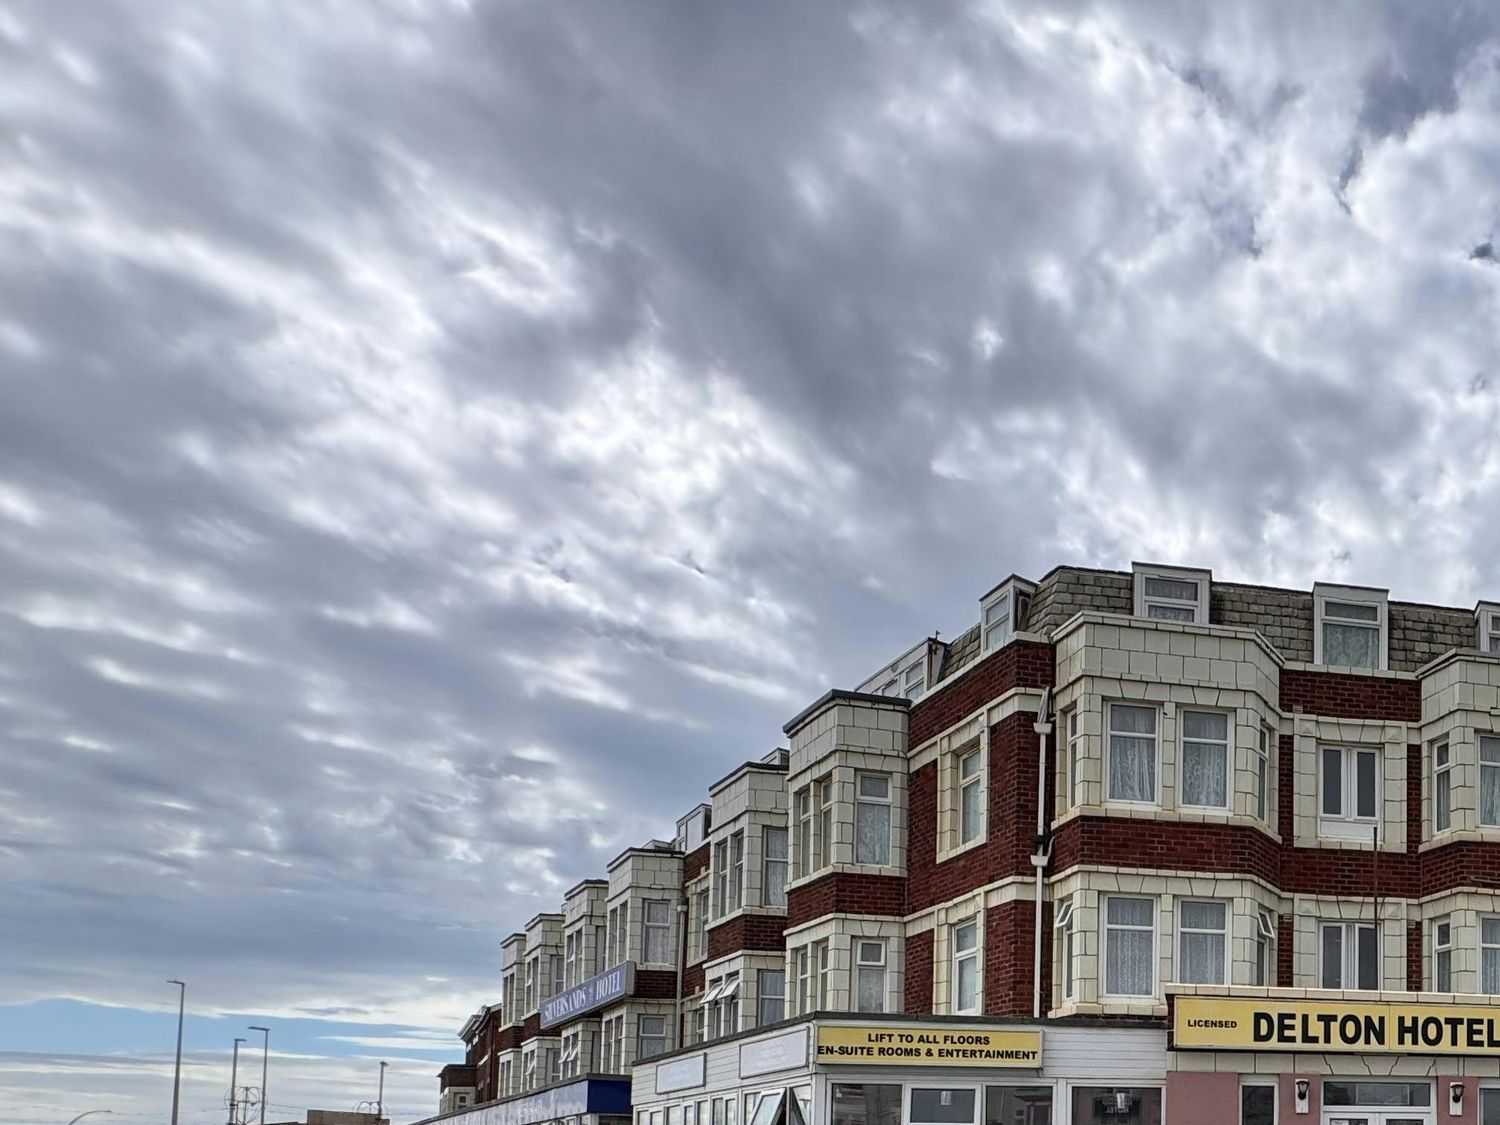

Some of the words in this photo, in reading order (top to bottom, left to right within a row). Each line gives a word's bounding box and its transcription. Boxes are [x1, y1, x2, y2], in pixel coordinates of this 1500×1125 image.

[596, 971, 620, 1000] HOTEL
[1187, 1019, 1237, 1028] LICENSED
[1253, 1012, 1385, 1045] DELTON
[868, 1033, 894, 1043] LIFT
[898, 1034, 914, 1044] TO
[917, 1034, 939, 1044] ALL
[943, 1035, 990, 1045] FLOORS
[817, 1045, 874, 1056] EN-SUITE
[878, 1047, 921, 1057] ROOMS
[925, 1048, 934, 1057] &
[938, 1048, 1038, 1060] ENTERTAINMENT
